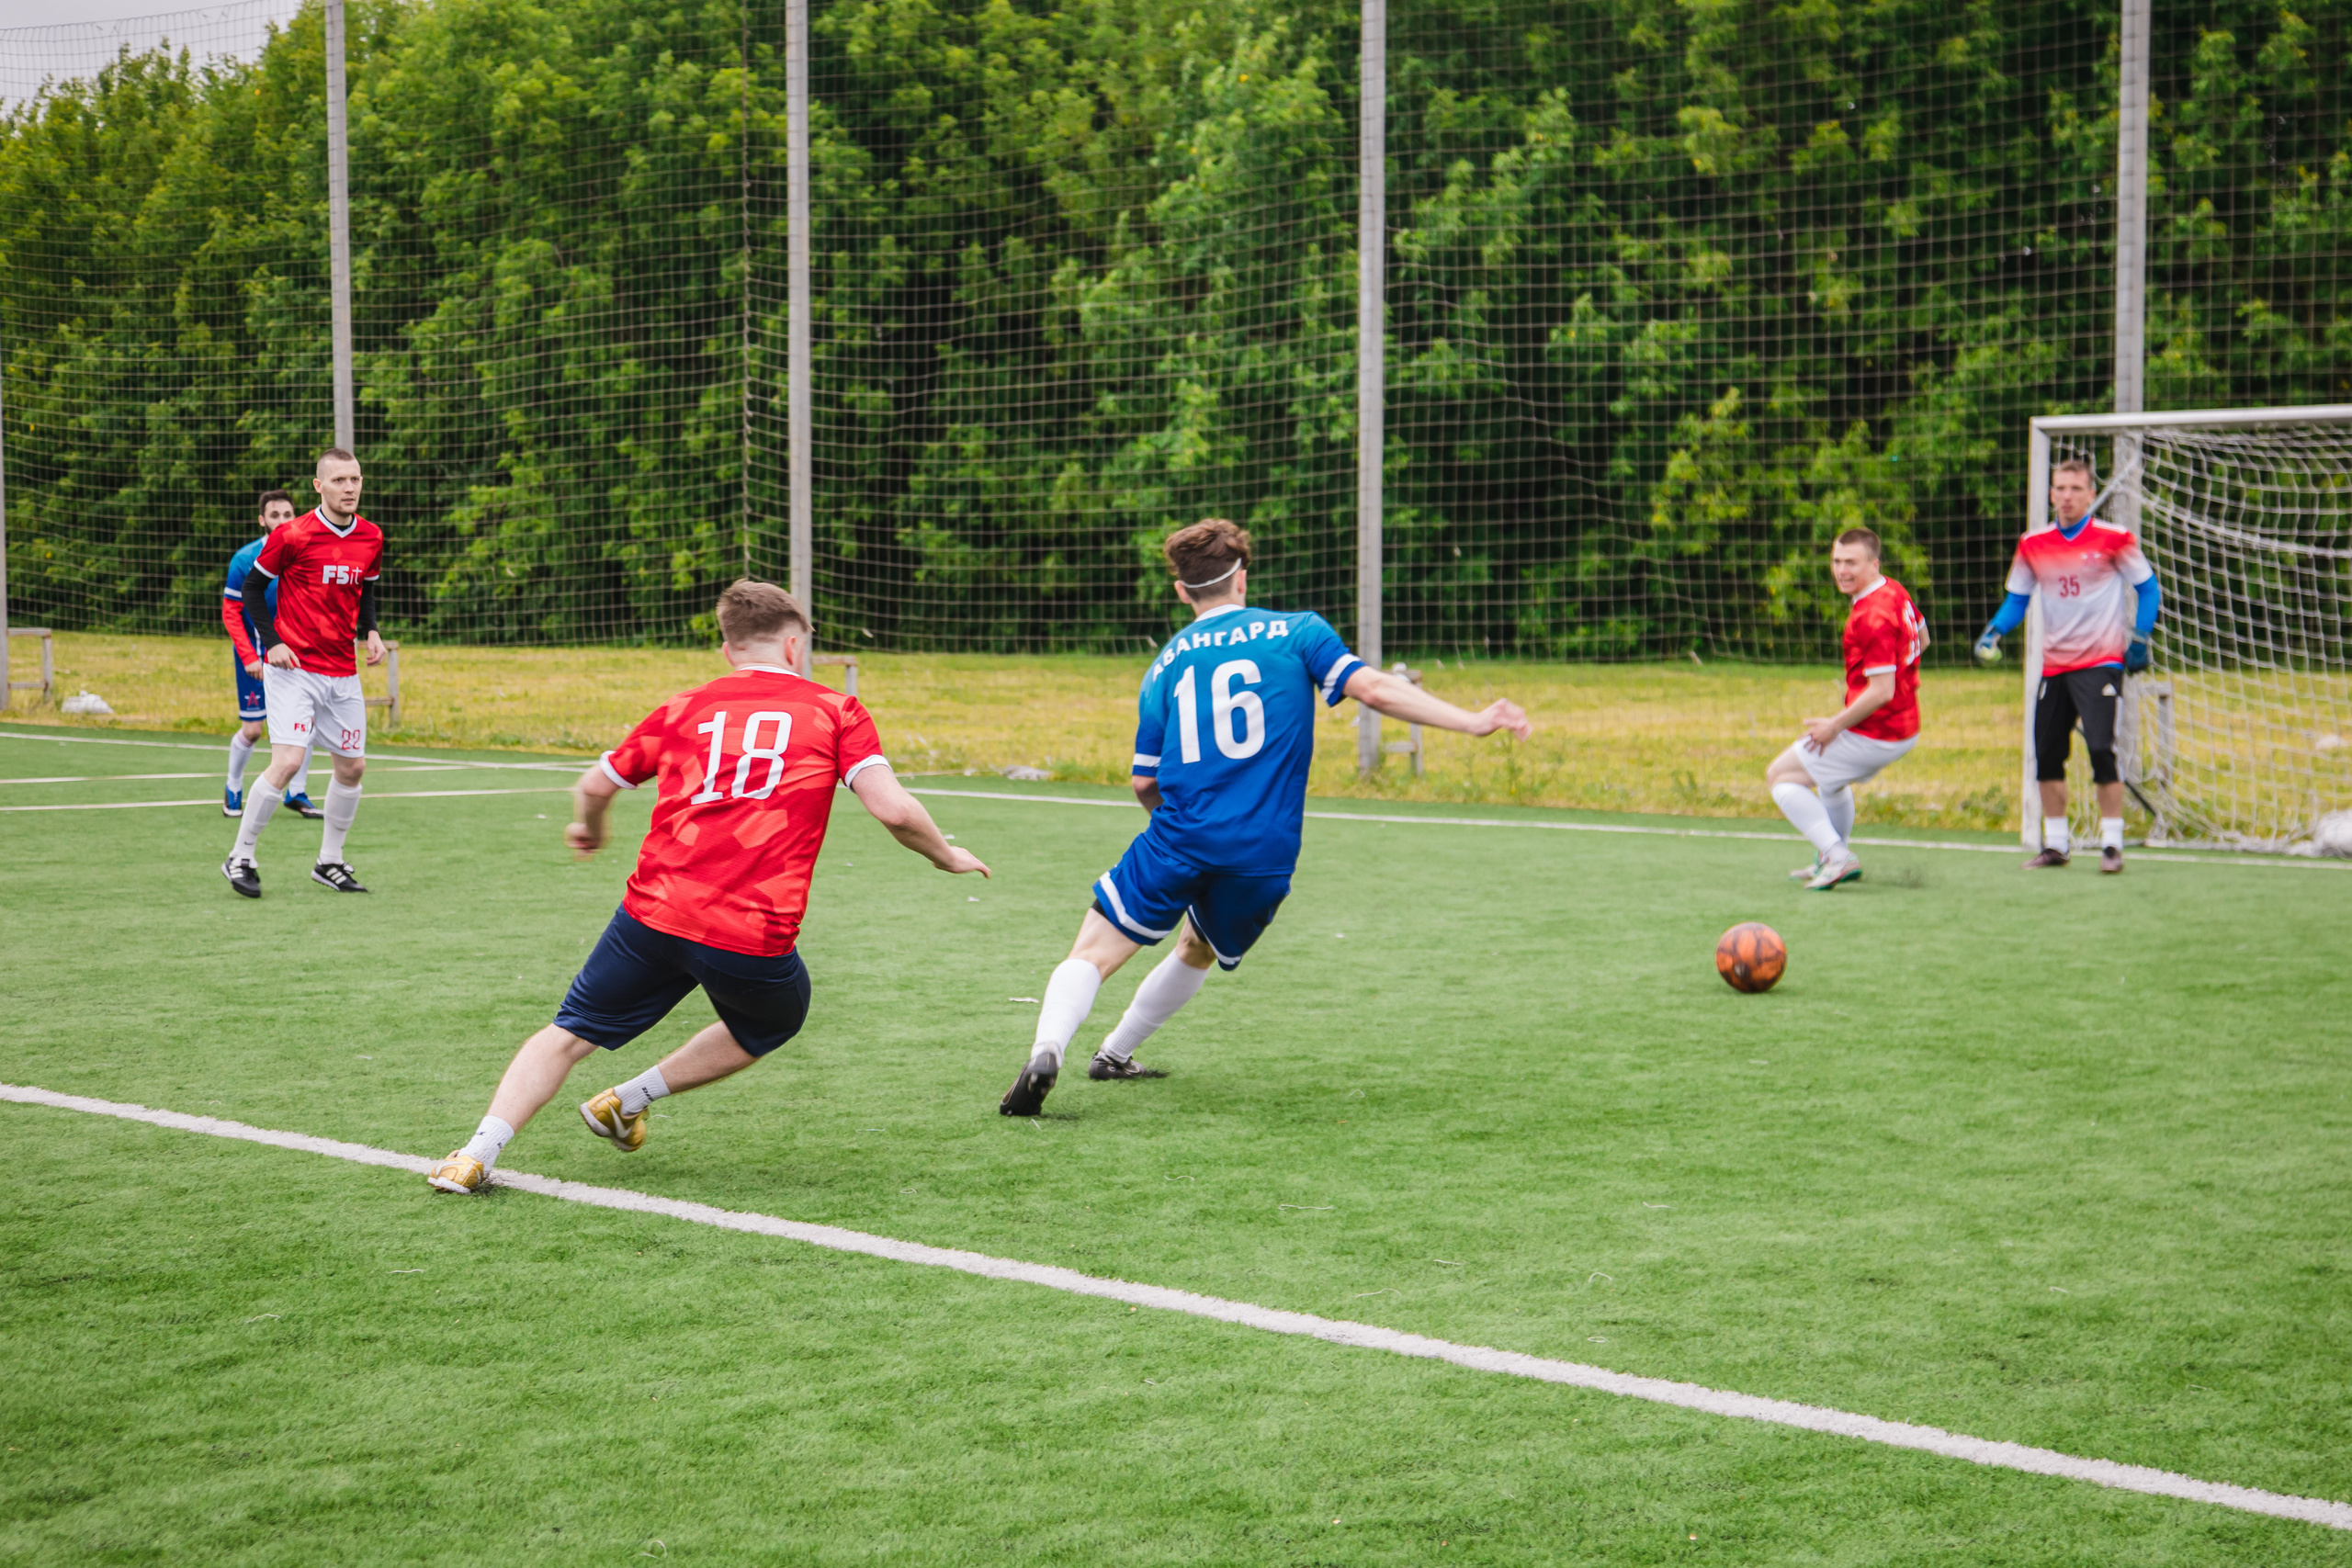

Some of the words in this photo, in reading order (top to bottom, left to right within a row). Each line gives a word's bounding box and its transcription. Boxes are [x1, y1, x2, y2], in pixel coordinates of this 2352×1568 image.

[322, 565, 362, 585] F5it
[2059, 575, 2080, 598] 35
[1173, 659, 1266, 764] 16
[341, 729, 361, 750] 22
[690, 711, 792, 806] 18
